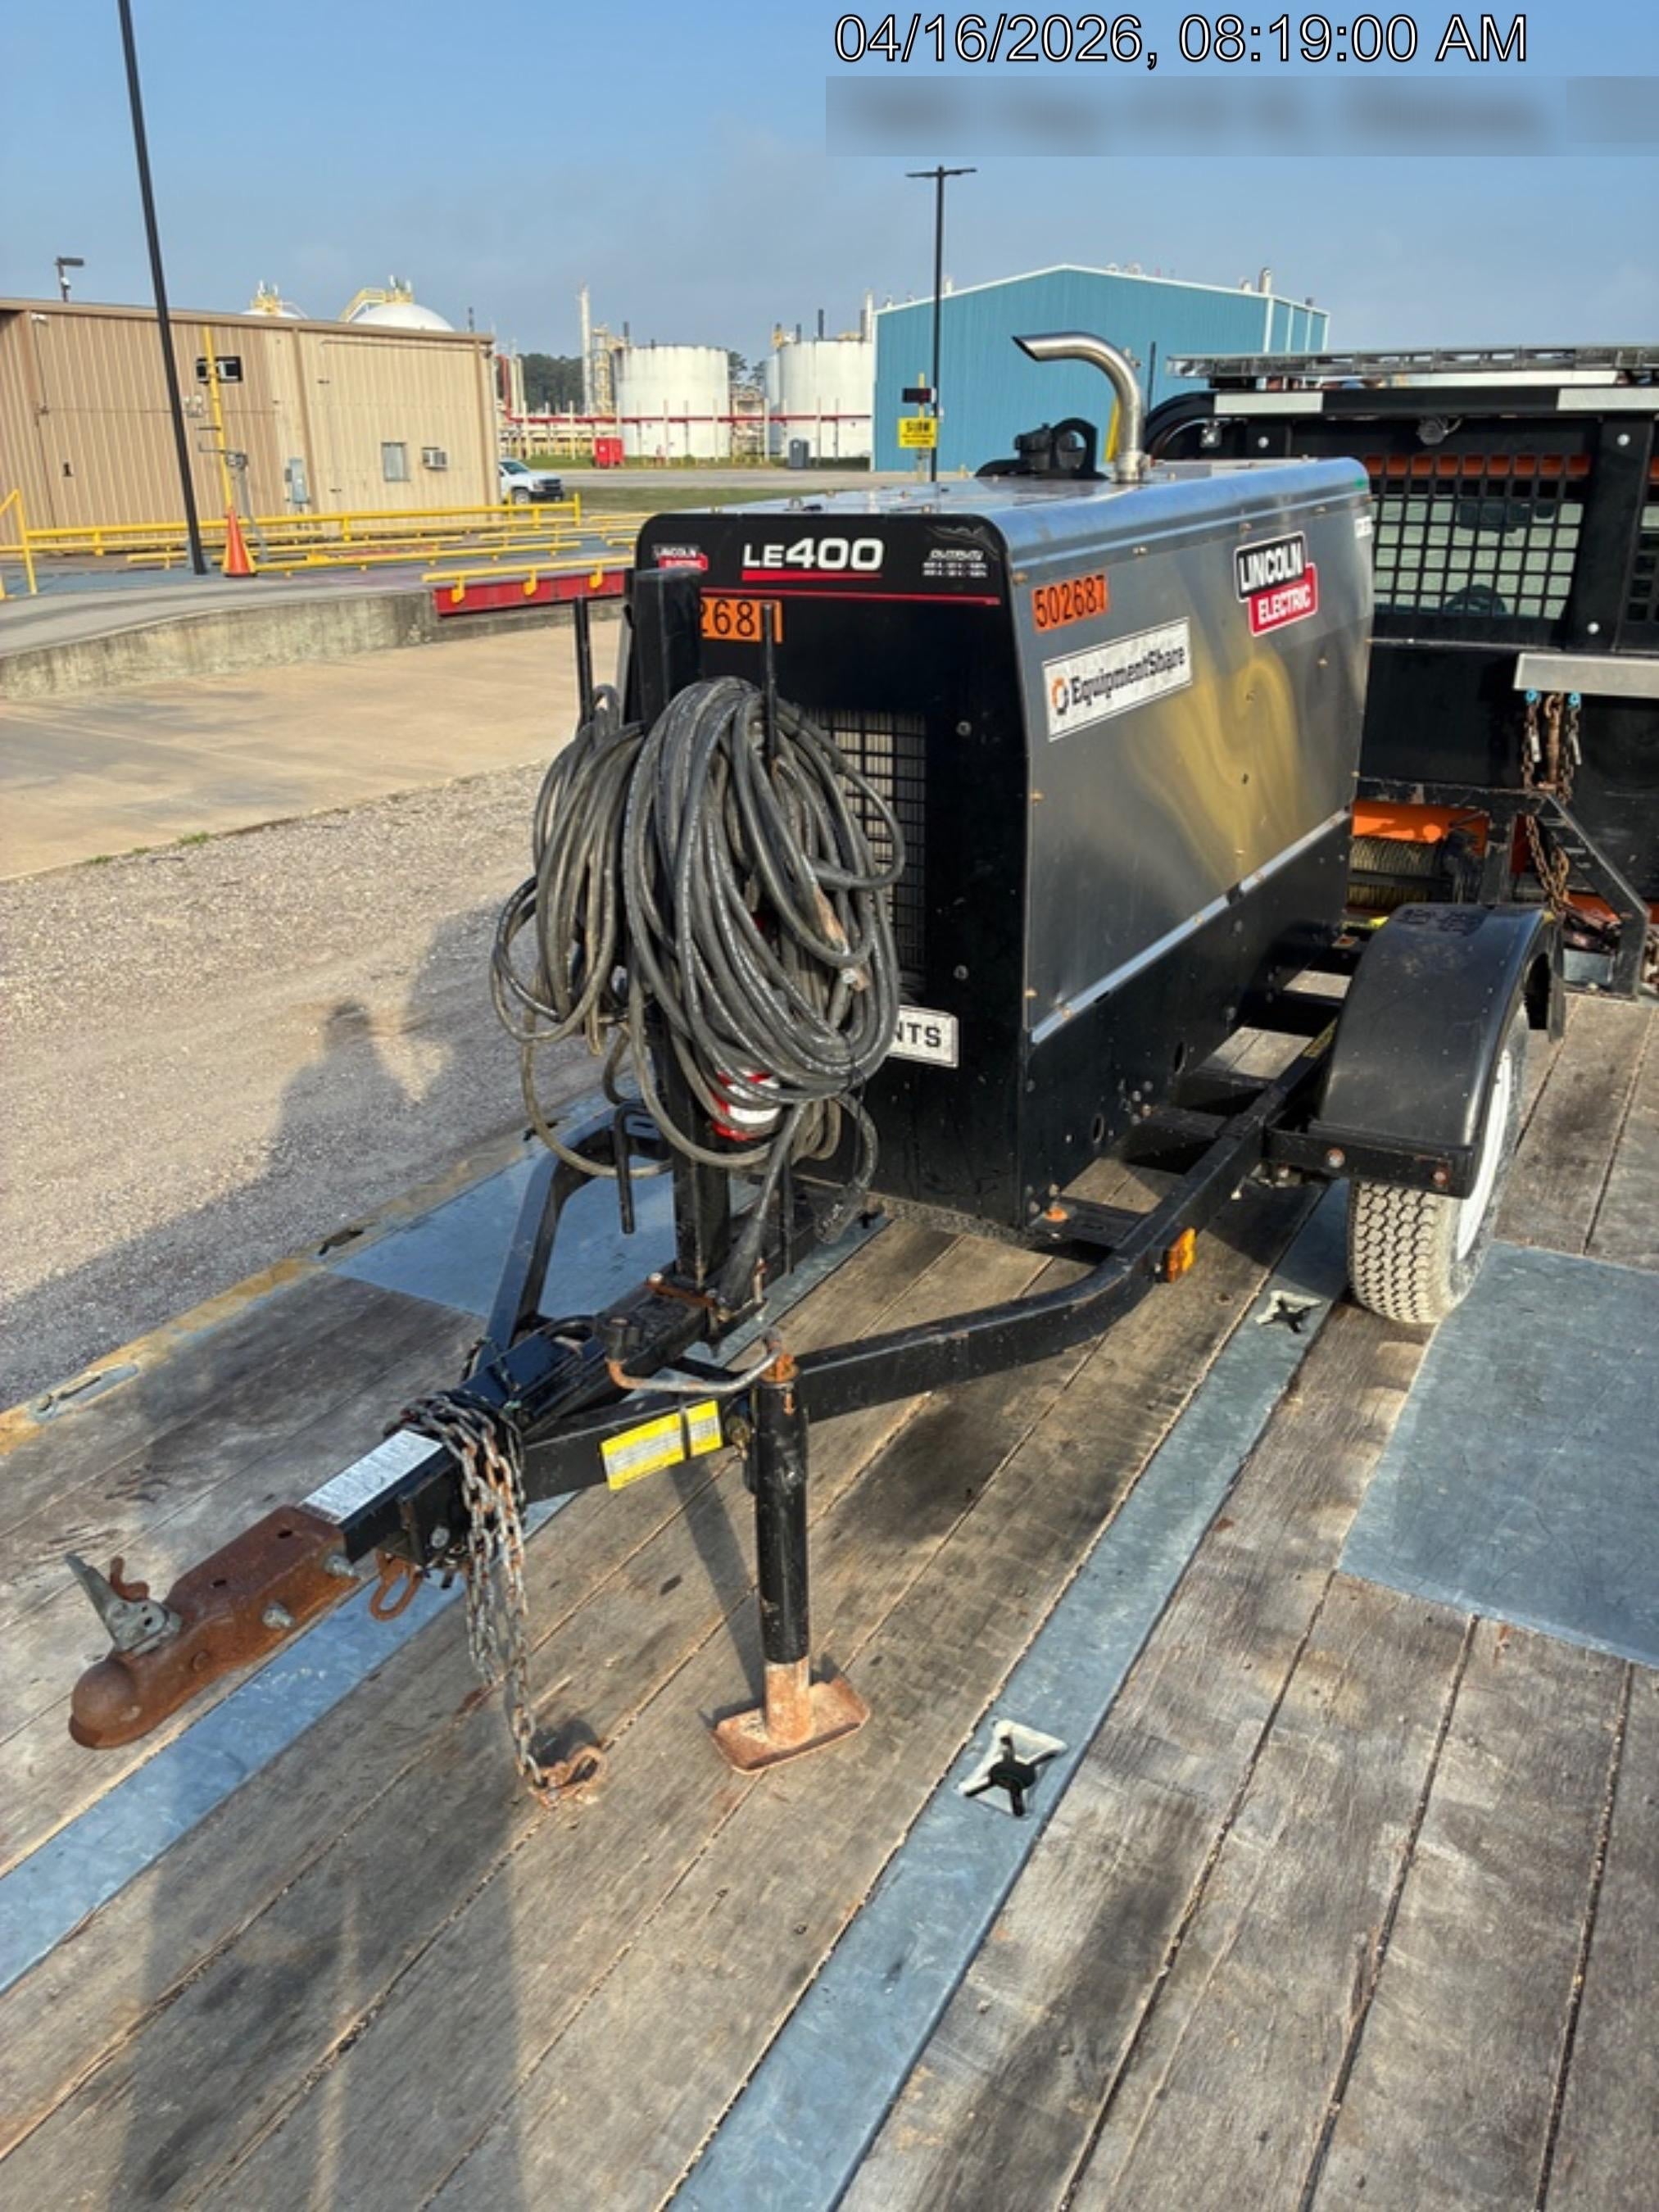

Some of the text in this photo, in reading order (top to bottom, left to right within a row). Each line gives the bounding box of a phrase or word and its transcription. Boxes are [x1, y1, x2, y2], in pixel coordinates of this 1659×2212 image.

[742, 537, 884, 571] LE400
[1239, 539, 1305, 591] LINCOLN
[699, 599, 755, 637] 268
[1034, 574, 1106, 628] 502687
[1257, 585, 1312, 625] ELECTRIC
[1070, 646, 1185, 706] EquipmentShare
